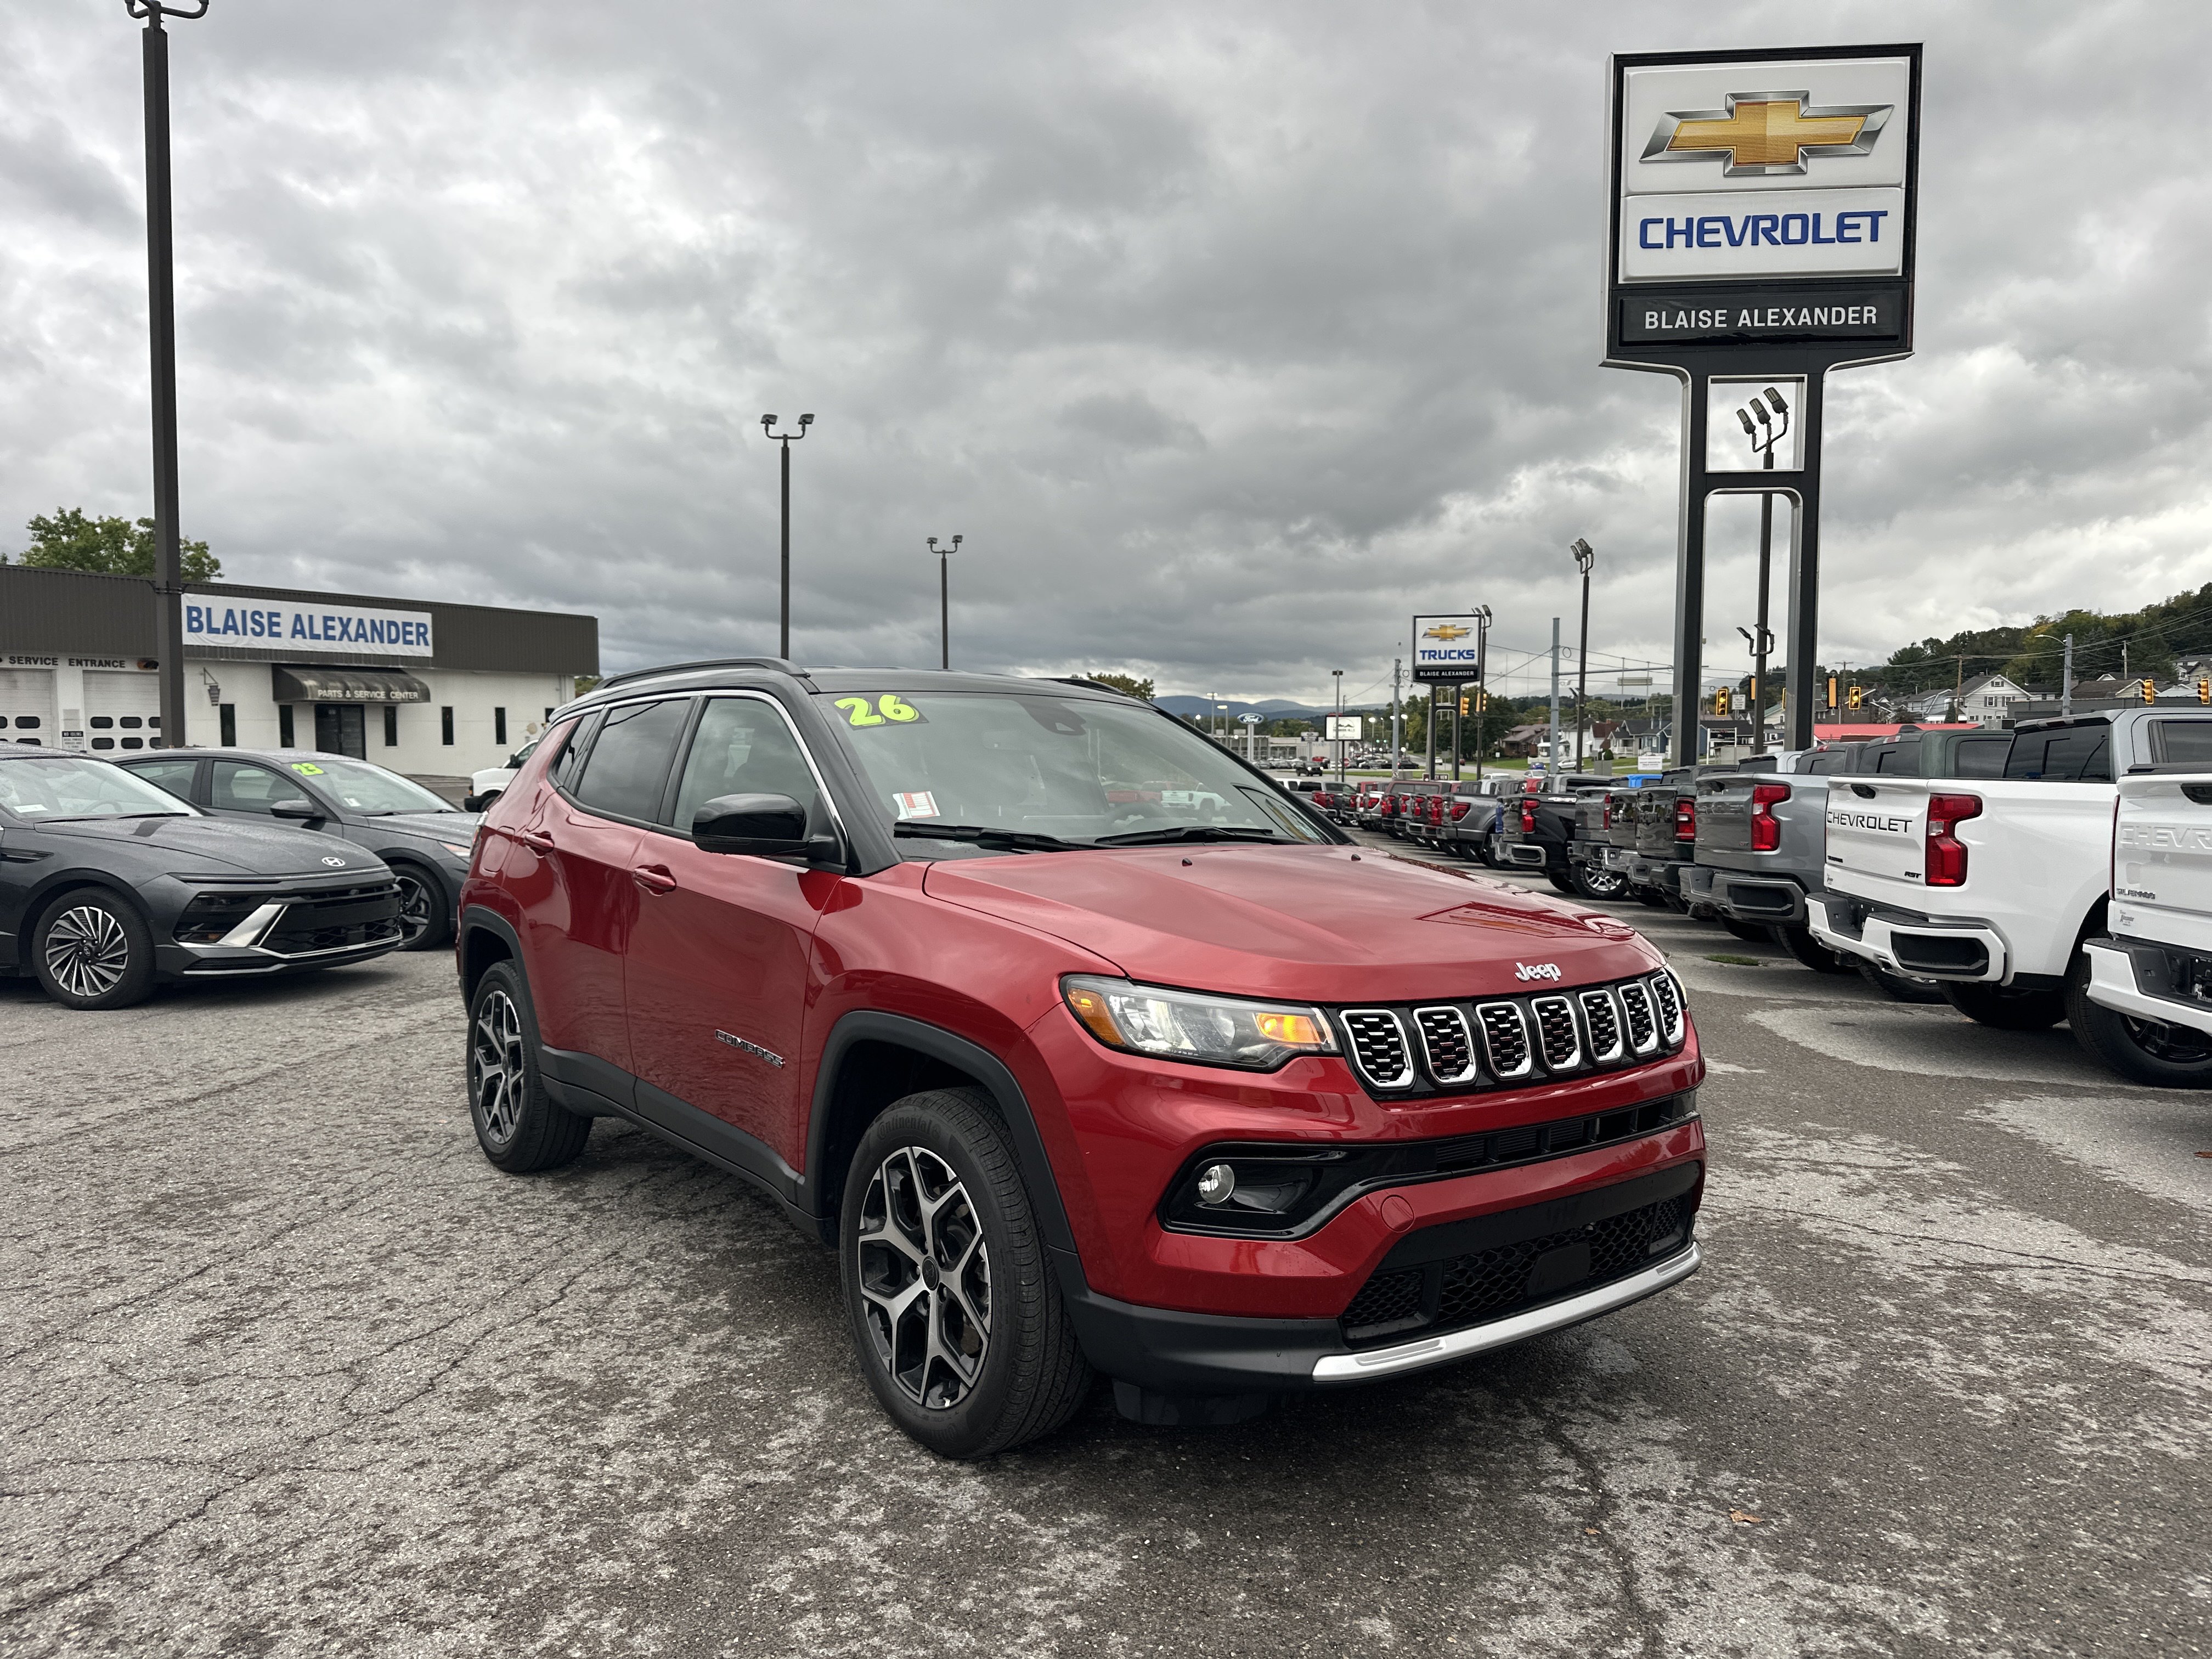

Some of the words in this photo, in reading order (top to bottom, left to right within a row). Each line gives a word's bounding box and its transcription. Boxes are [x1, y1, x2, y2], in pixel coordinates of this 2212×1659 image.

[1639, 211, 1888, 249] CHEVROLET
[1645, 309, 1728, 329] BLAISE
[1737, 306, 1877, 327] ALEXANDER
[186, 606, 282, 637] BLAISE
[291, 613, 429, 646] ALEXANDER
[9, 656, 59, 665] SERVICE
[68, 658, 126, 668] ENTRANCE
[1419, 650, 1475, 660] TRUCKS
[318, 690, 342, 698] PARTS
[354, 690, 386, 699] SERVICE
[390, 691, 419, 699] CENTER
[834, 694, 919, 726] 26
[1827, 811, 1912, 833] CHEVROLET
[1514, 962, 1562, 983] Jeep
[715, 1029, 785, 1069] COMPASS
[878, 1114, 933, 1139] Continental
